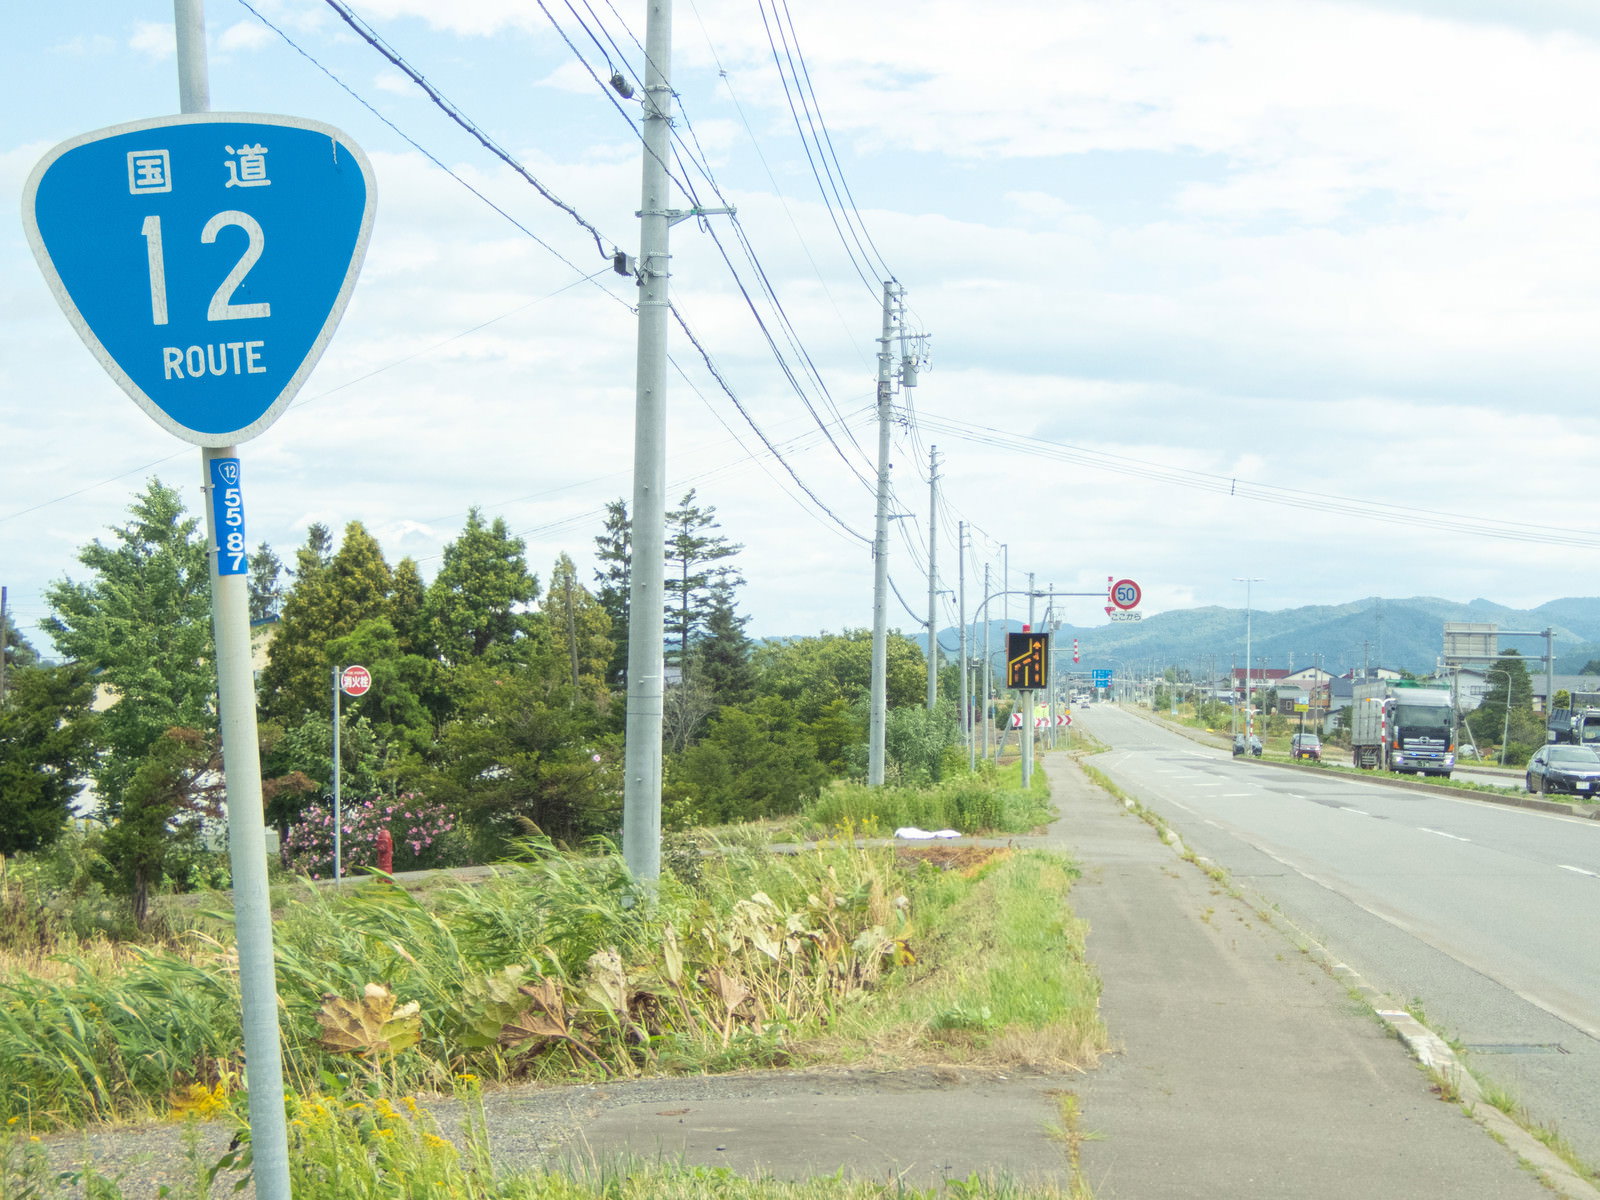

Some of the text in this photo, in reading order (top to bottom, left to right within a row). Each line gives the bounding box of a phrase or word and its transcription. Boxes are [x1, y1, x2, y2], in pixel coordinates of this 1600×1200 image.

[126, 143, 272, 195] 国道
[141, 210, 271, 326] 12
[163, 340, 267, 380] ROUTE
[224, 465, 236, 478] 12
[1117, 587, 1135, 601] 50
